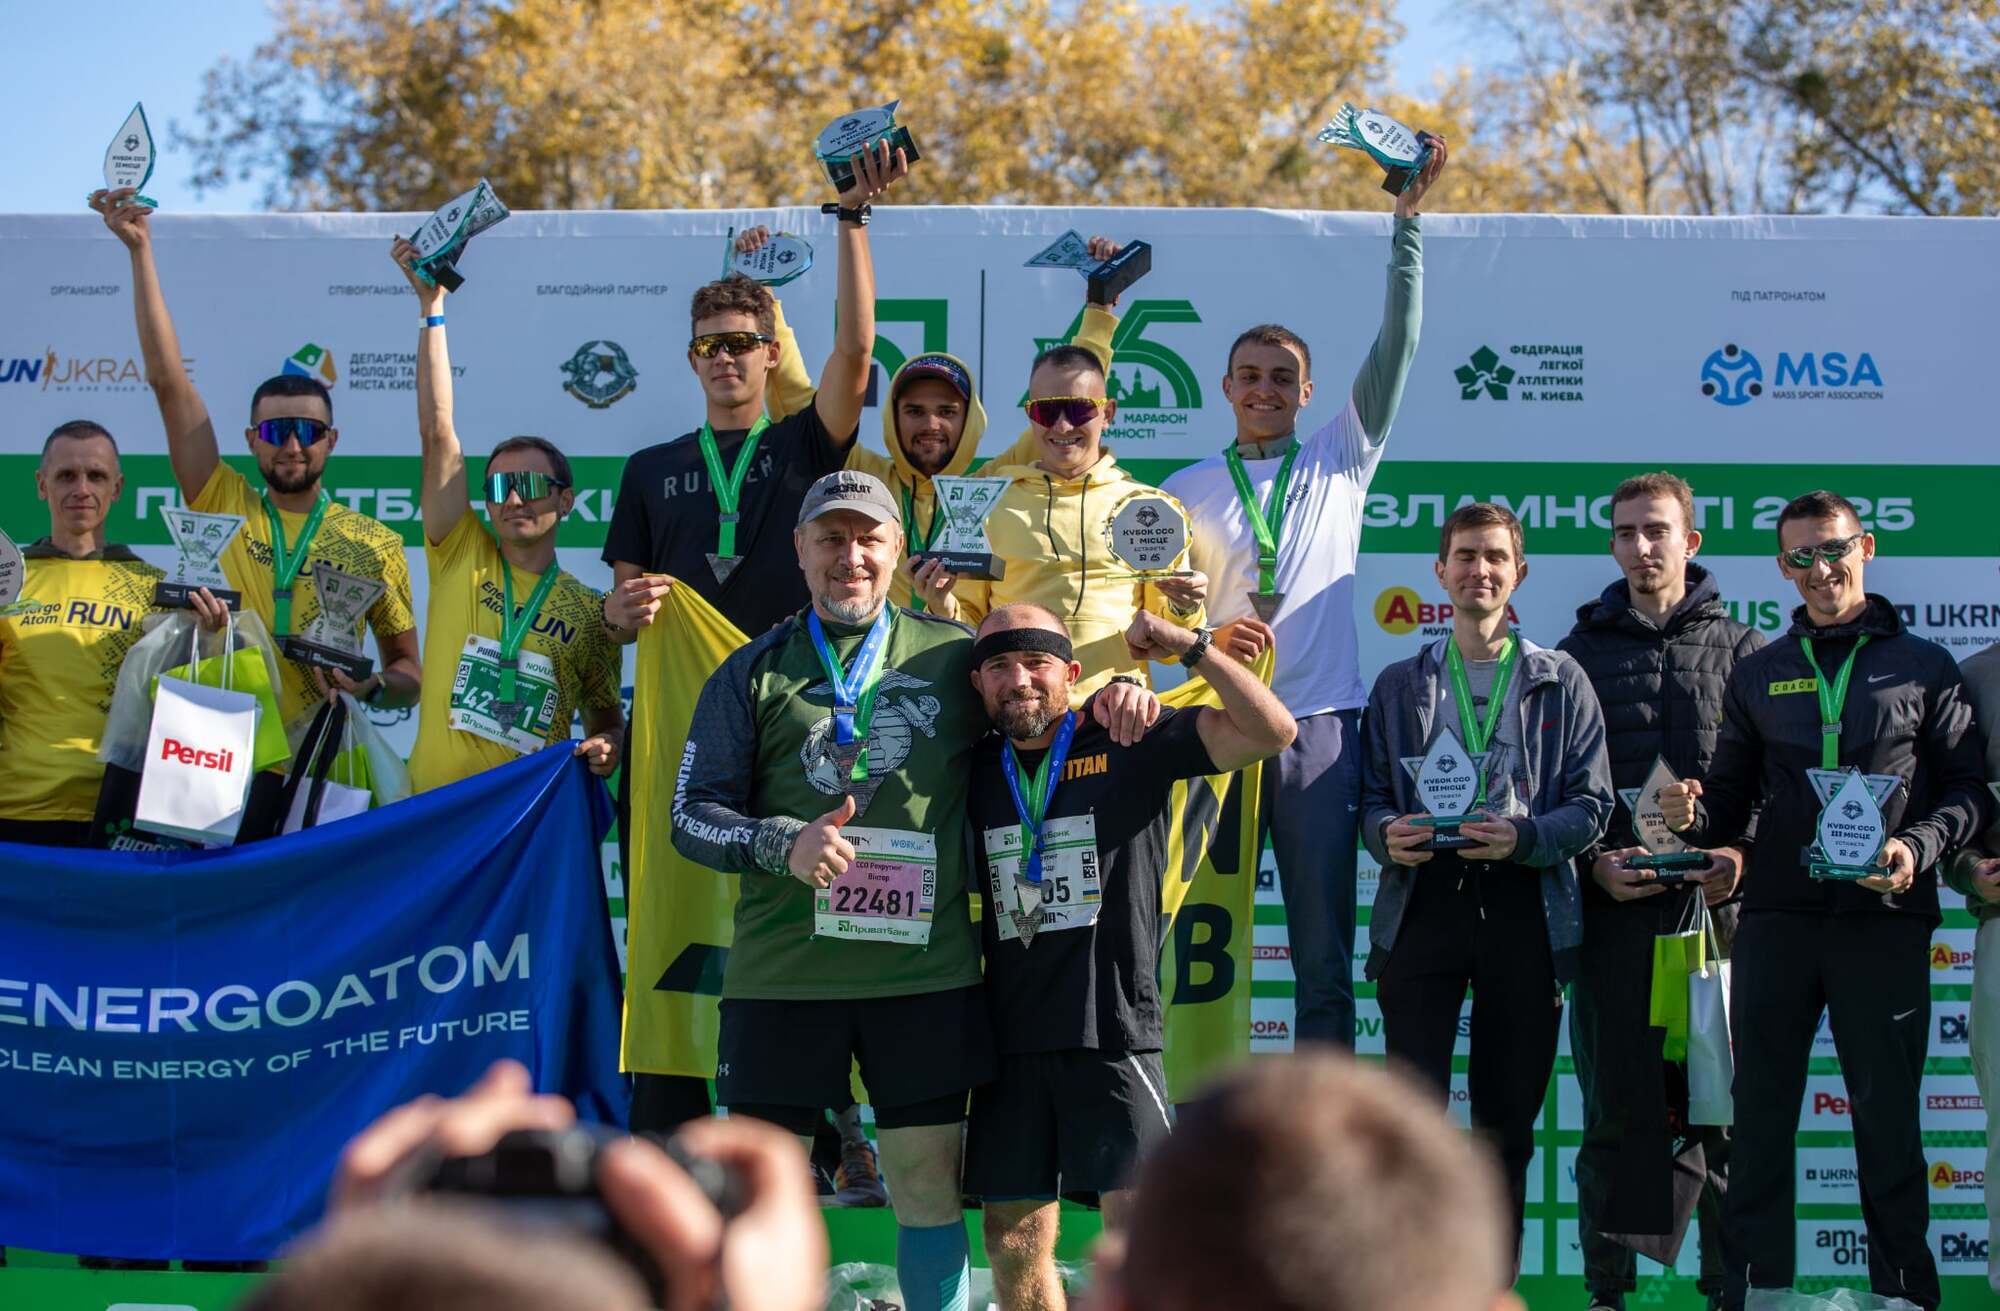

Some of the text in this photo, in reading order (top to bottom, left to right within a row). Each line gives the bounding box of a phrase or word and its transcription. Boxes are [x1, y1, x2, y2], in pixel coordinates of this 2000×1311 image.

[50, 286, 120, 296] ОРГАНІЗАТОР
[328, 286, 417, 296] СПІВОРГАНІЗАТО
[536, 284, 668, 296] БЛАГОДІЙНИЙ ПАРТНЕР
[1732, 291, 1826, 302] ПІД ПАТРОНАТОМ
[1510, 345, 1583, 356] ФЕДЕРАЦІЯ
[350, 353, 417, 365] ДЕПАРТАМ
[1539, 358, 1584, 370] ЛЕГКОЇ
[350, 366, 414, 379] МОЛОДІ ТА
[1774, 352, 1883, 387] MSA
[350, 380, 418, 390] МІСТА КИЄ
[1518, 376, 1584, 386] АТЛЕТИКИ
[1522, 391, 1584, 401] М. КИЄВА
[1772, 391, 1884, 400] MASS SPORT ASSOCIATION
[1124, 414, 1188, 424] МАРАФОН
[178, 563, 185, 576] 2
[20, 614, 58, 626] Atom
[66, 600, 133, 630] RUN
[315, 620, 324, 634] 2
[1950, 636, 1969, 647] ЩО
[1774, 680, 1814, 692] COACH
[161, 738, 234, 773] Persil
[1827, 822, 1856, 830] КУБОК
[1844, 832, 1870, 840] МІСЦЕ
[835, 886, 914, 918] 22481
[850, 924, 912, 937] ПриватБанк
[0, 932, 530, 1034] ENERGOATOM
[0, 1009, 530, 1079] CLEAN ENERGY OF THE FUTURE
